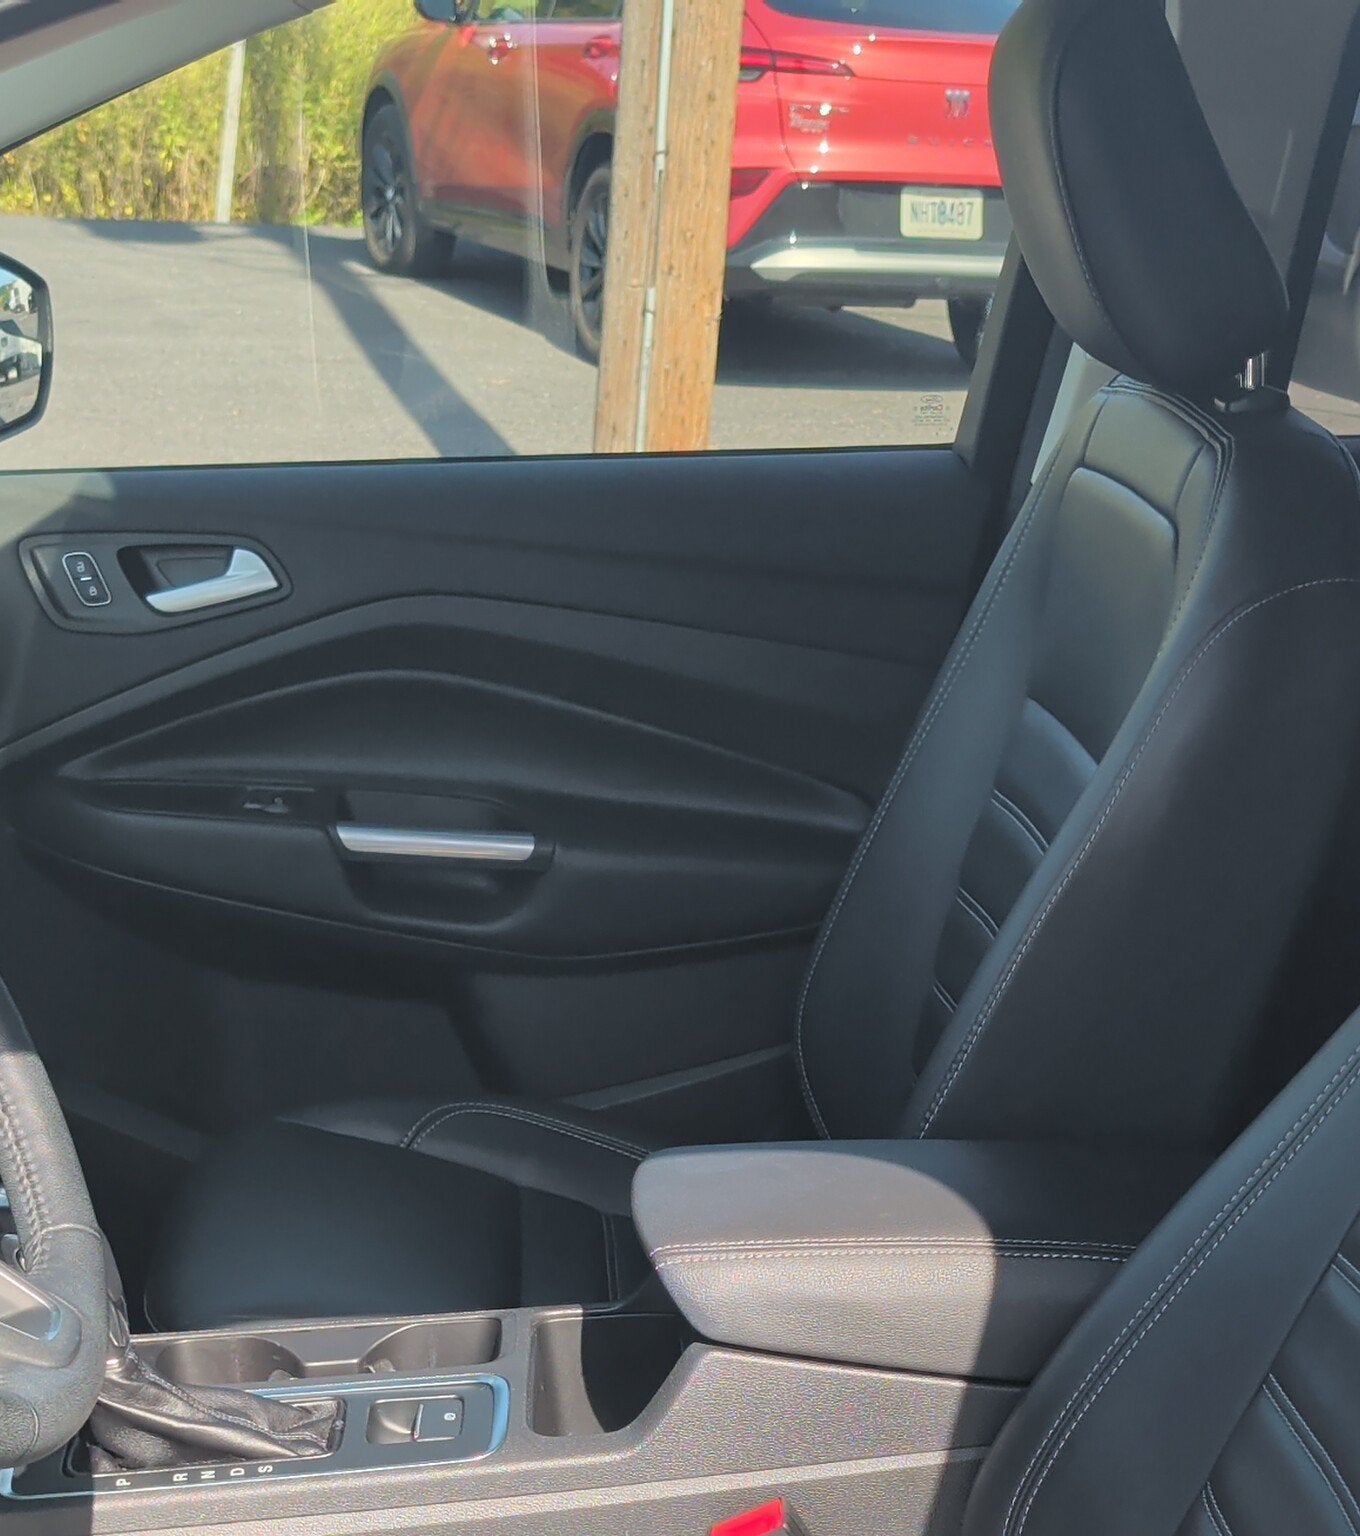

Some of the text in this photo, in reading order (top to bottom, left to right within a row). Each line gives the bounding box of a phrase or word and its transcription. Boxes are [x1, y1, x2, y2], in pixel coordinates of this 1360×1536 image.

[116, 1464, 273, 1486] P R N D S
